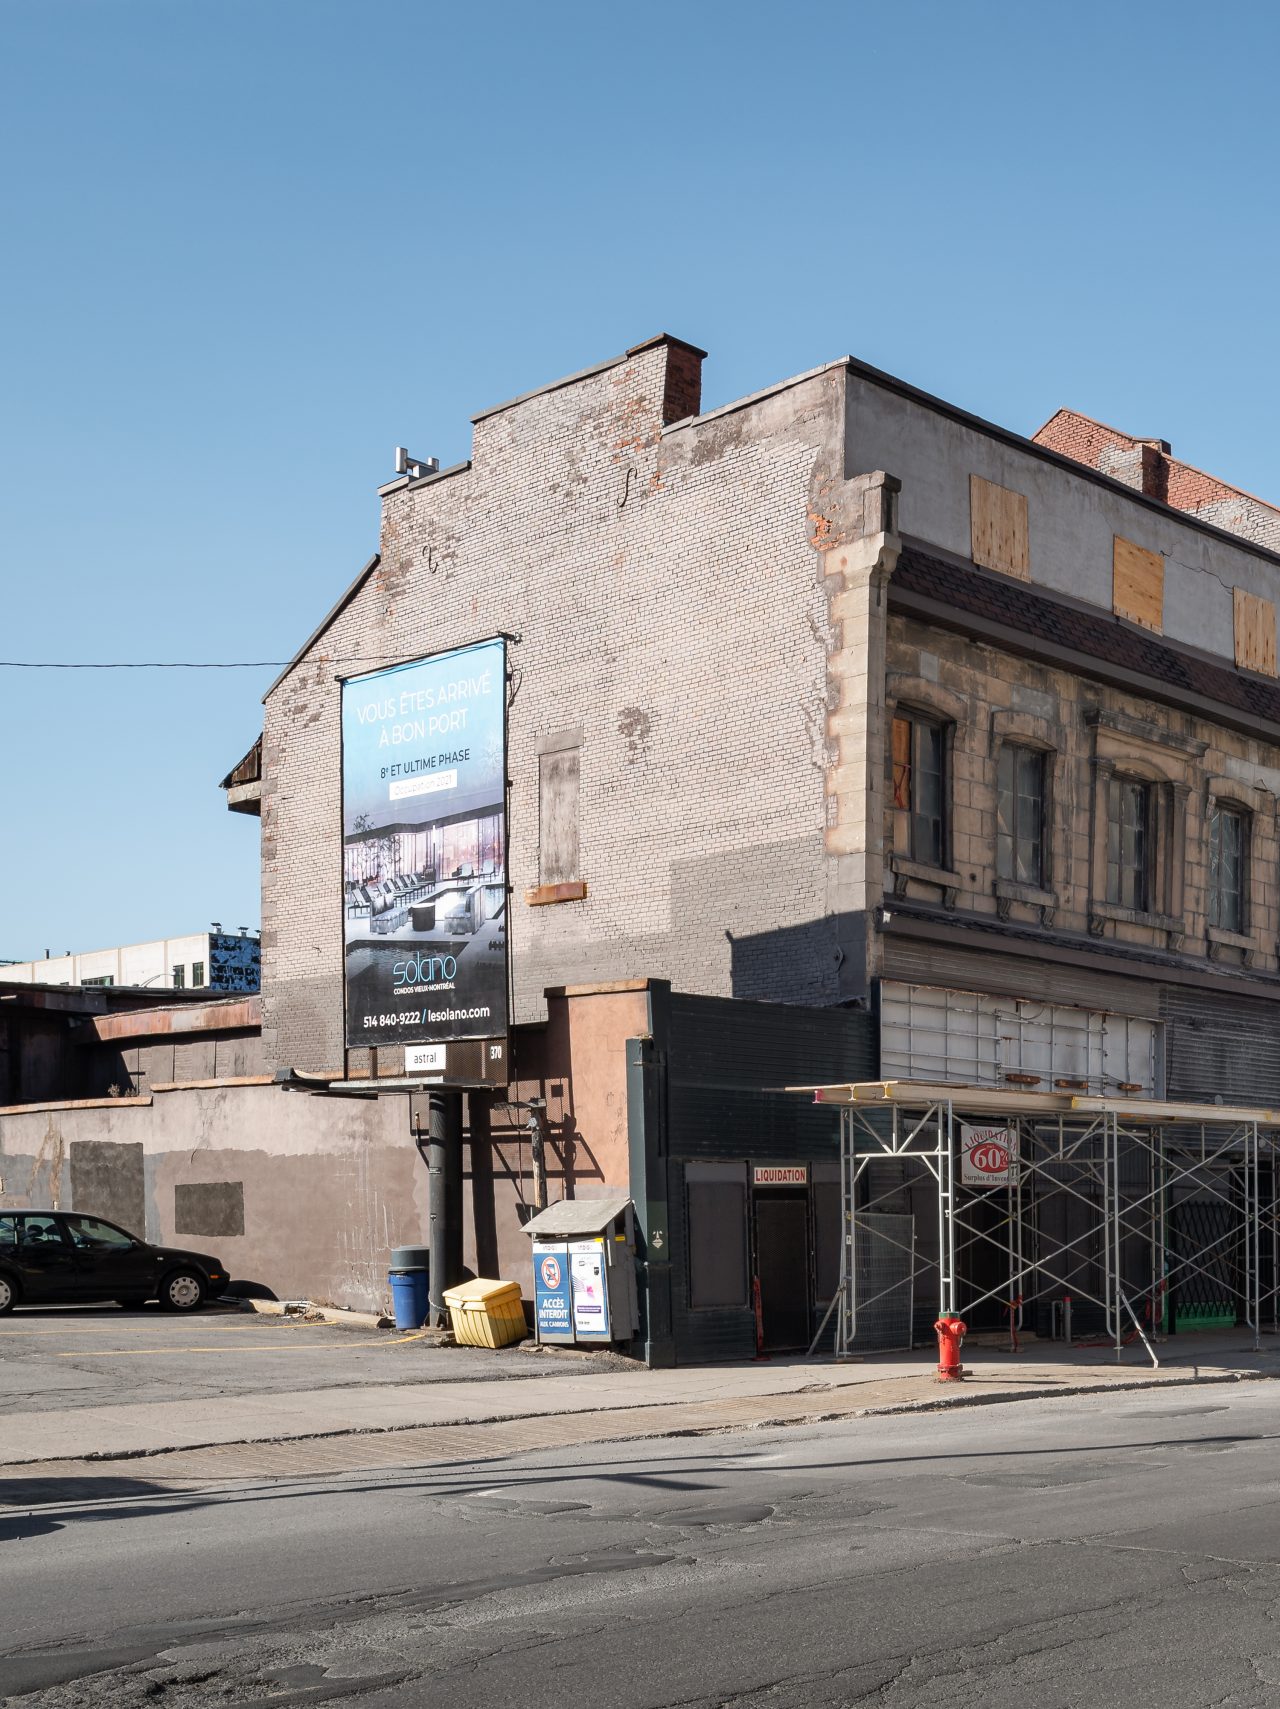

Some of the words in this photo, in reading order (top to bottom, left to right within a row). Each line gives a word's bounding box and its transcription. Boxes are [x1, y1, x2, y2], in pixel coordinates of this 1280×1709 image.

[357, 698, 396, 725] VOUS
[400, 688, 434, 715] ÊTES
[437, 669, 492, 705] ARRIVÉ
[378, 724, 389, 748] À
[392, 719, 425, 744] BON
[429, 708, 469, 736] PORT
[391, 763, 401, 776] ET
[403, 756, 436, 773] ULTIME
[438, 748, 470, 766] PHASE
[393, 951, 456, 985] solano
[393, 986, 414, 995] CONDOS
[363, 1015, 378, 1028] 514
[379, 1011, 420, 1027] 840-9222
[428, 1006, 490, 1023] lesolano.com
[414, 1052, 437, 1064] astral
[490, 1045, 502, 1059] 370
[755, 1169, 805, 1182] LIQUIDATION
[964, 1174, 985, 1183] Surplus
[542, 1297, 564, 1309] ACCÈS
[539, 1309, 568, 1319] INTERDIT
